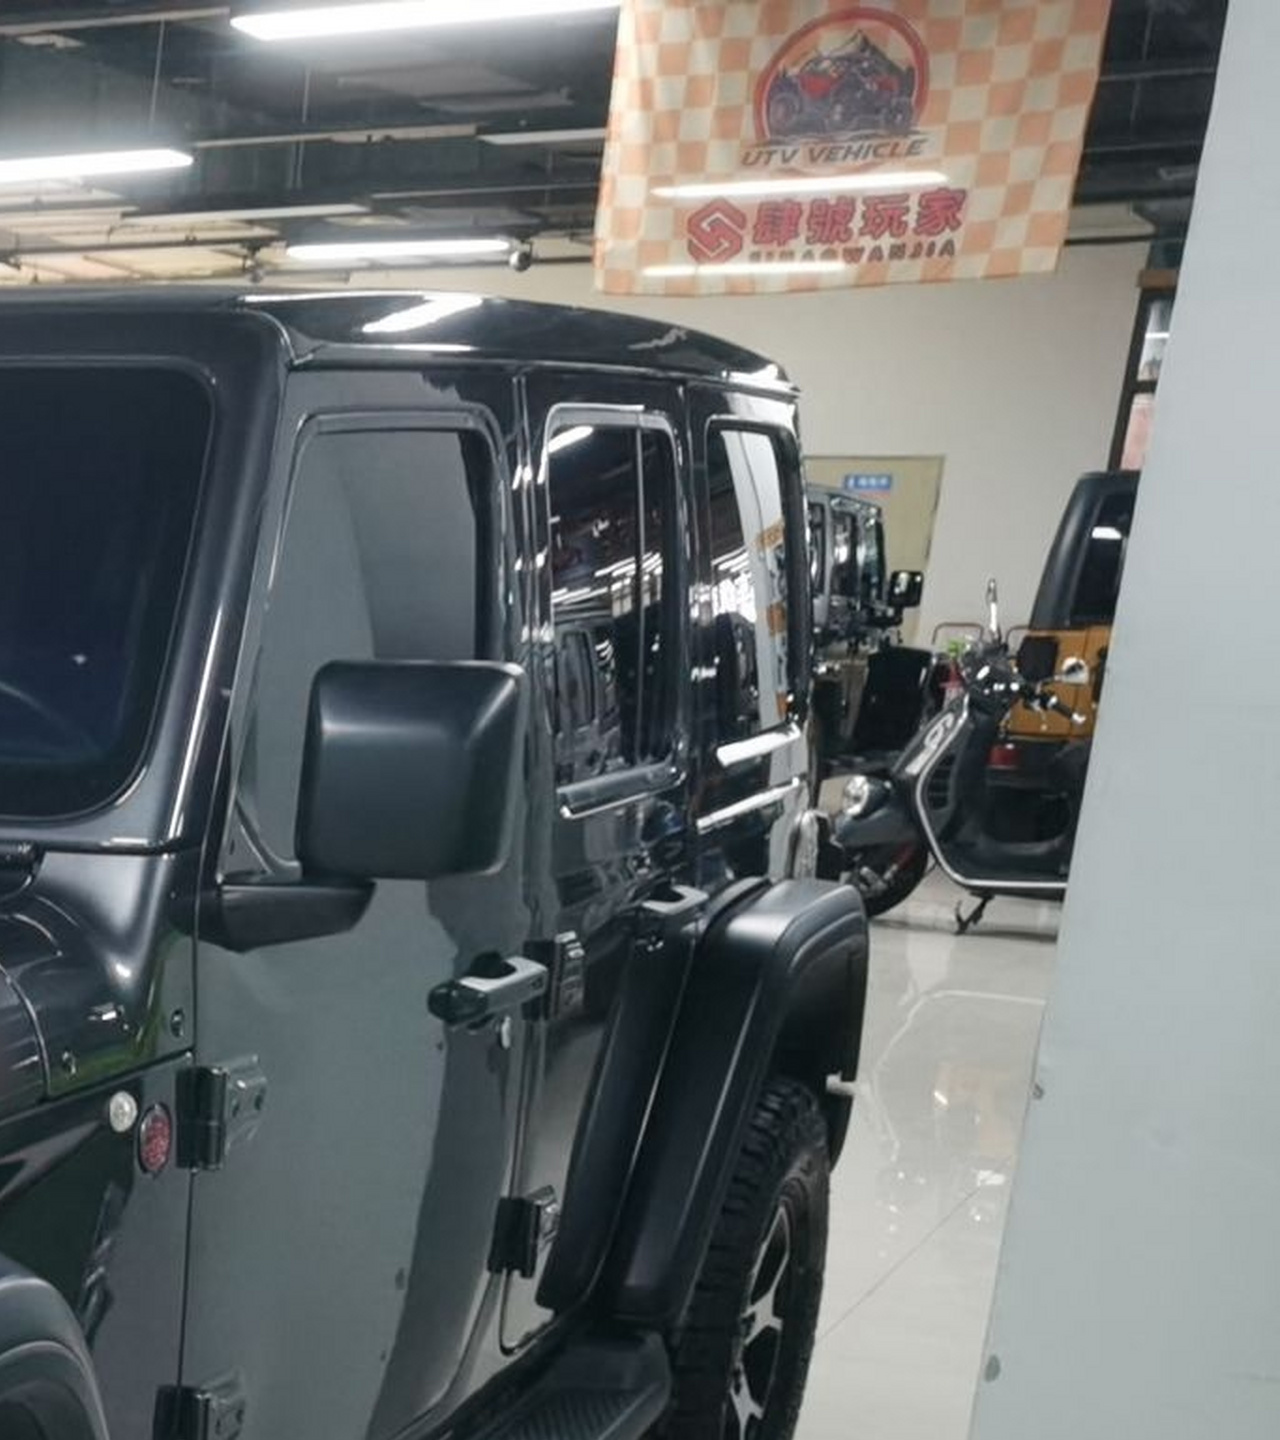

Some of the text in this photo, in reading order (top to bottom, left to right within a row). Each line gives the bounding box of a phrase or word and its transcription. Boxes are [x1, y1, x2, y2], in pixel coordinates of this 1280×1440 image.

[740, 138, 928, 167] UTV VEHICLE
[751, 187, 968, 246] 肆號玩家
